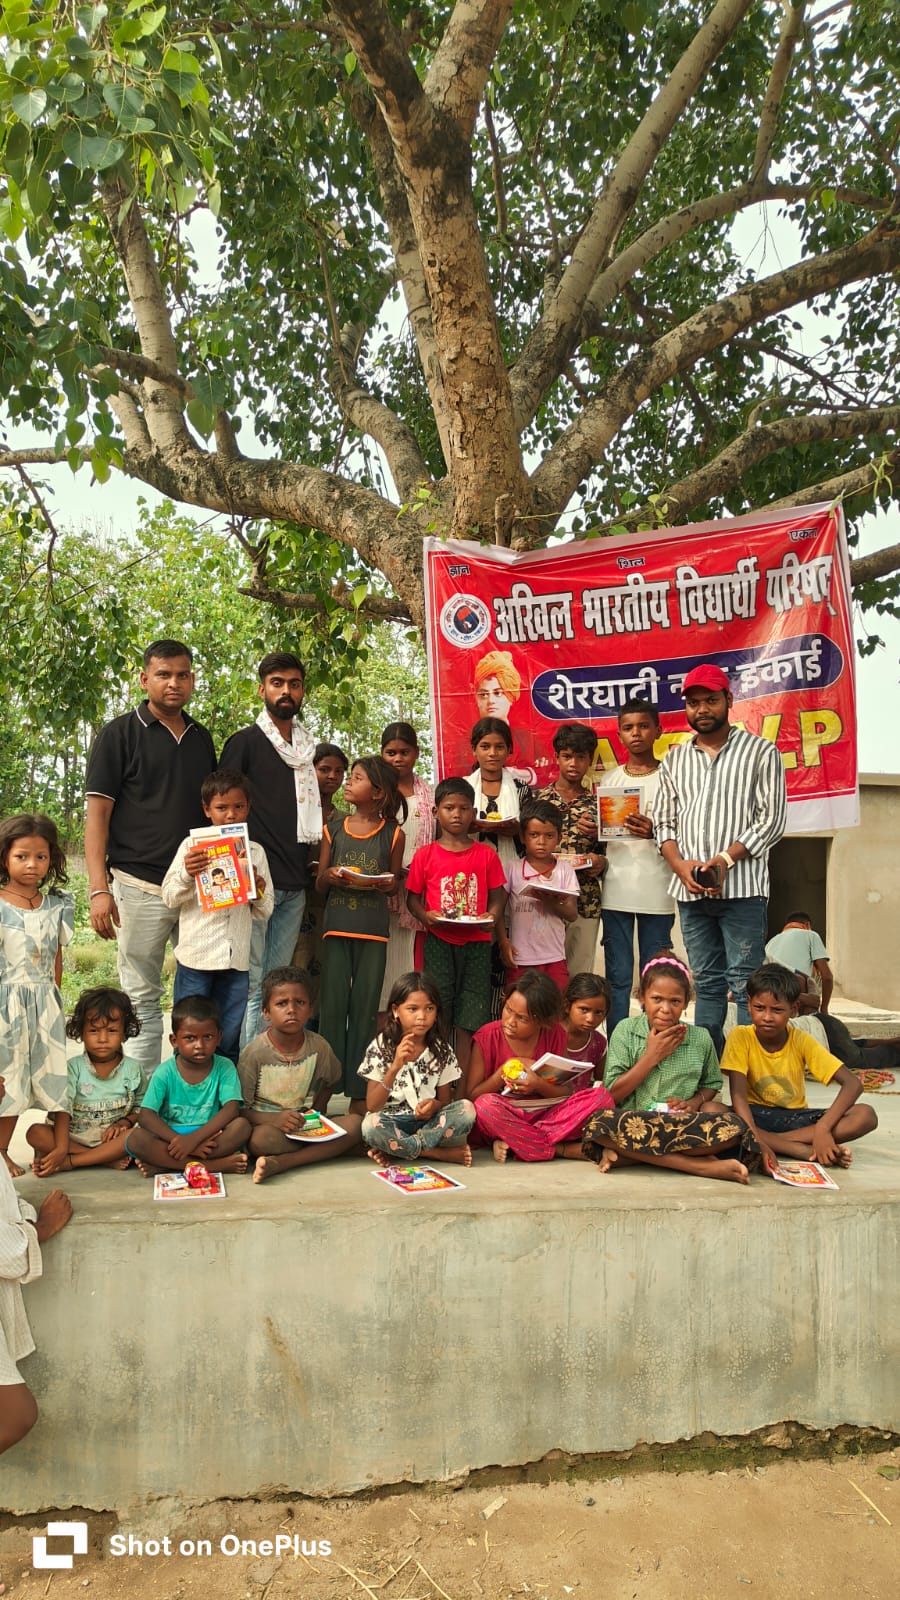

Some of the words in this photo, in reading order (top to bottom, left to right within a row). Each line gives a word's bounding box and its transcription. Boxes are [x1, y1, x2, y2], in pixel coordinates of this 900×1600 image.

[449, 564, 470, 577] ज्ञान
[493, 582, 574, 644] अखिल
[582, 572, 671, 636] भारतीय
[676, 556, 760, 627] विद्यार्थी
[547, 666, 660, 711] शेरघाटी
[733, 638, 823, 692] इकाई
